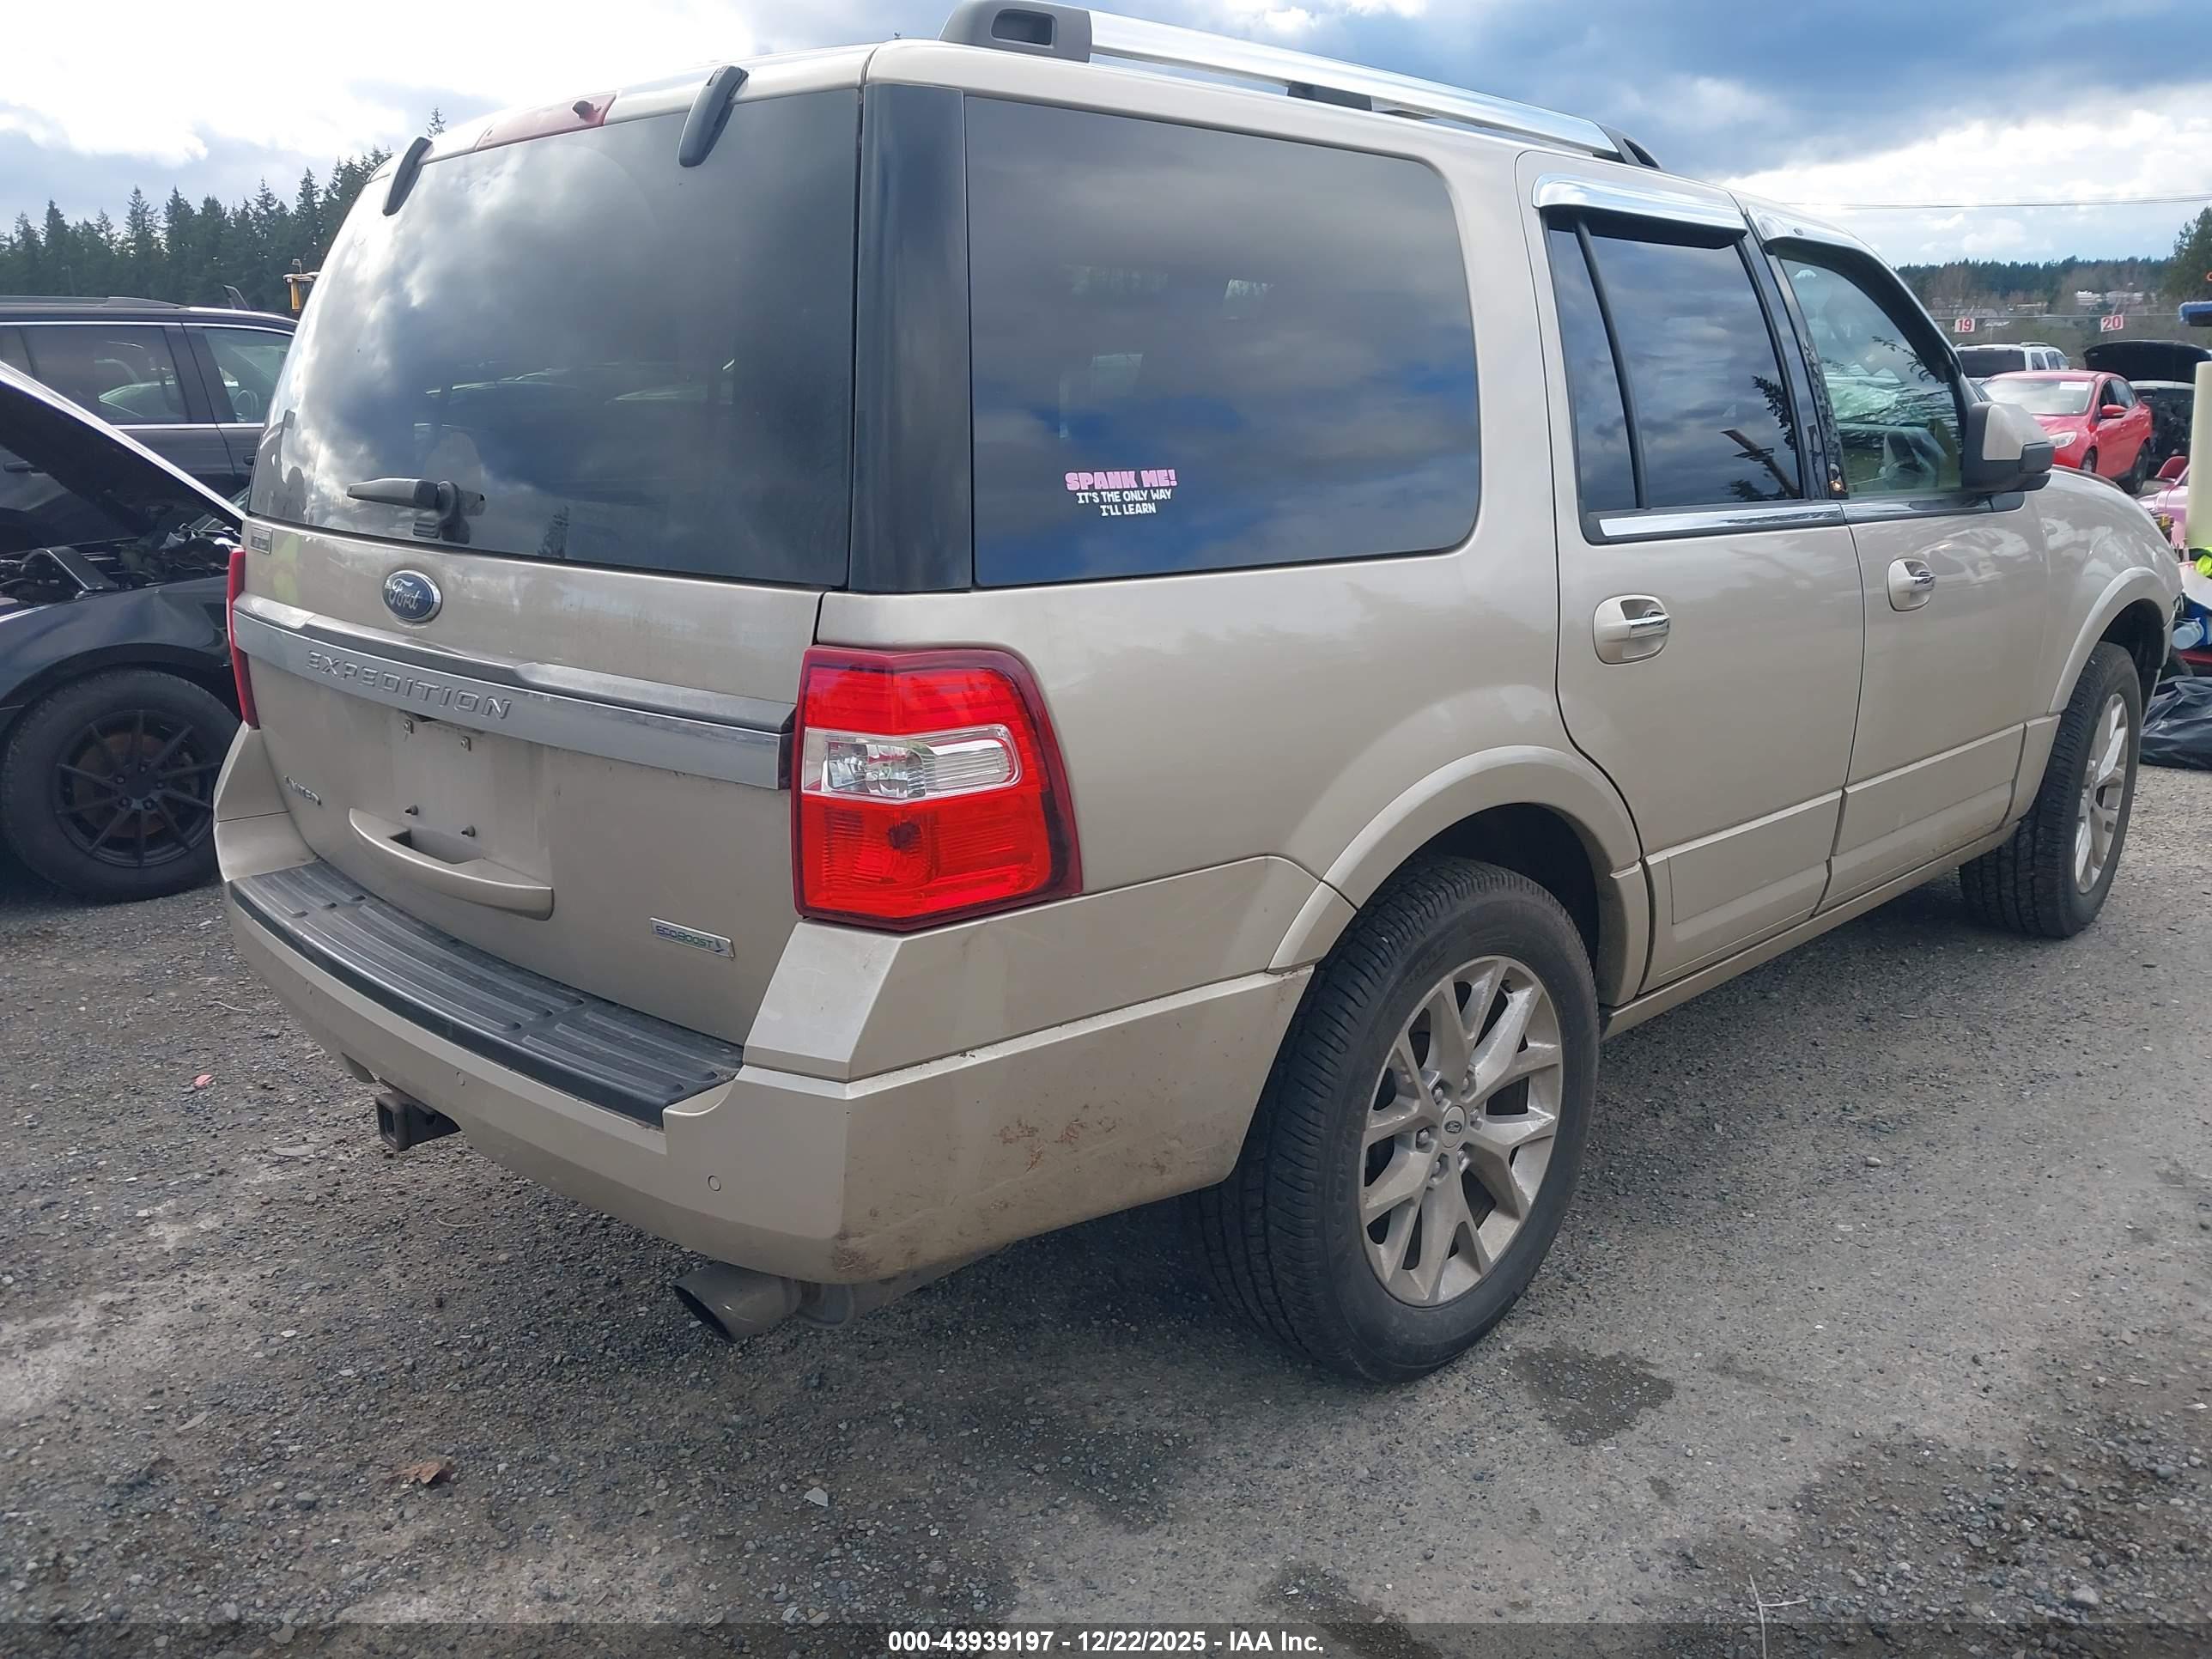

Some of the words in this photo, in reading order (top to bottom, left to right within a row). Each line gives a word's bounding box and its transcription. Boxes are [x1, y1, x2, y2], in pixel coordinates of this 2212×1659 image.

[1959, 319, 1972, 331] 19
[2102, 316, 2122, 331] 20
[1065, 471, 1139, 491] SPANK
[1140, 469, 1178, 488] ME!
[1076, 491, 1100, 504] IT'S
[1101, 490, 1121, 502] THE
[1122, 489, 1149, 502] ONLY
[1150, 489, 1172, 500] WAY
[1100, 503, 1121, 517] I'LL
[1123, 502, 1157, 515] LEARN
[388, 578, 421, 611] Ford
[306, 650, 513, 720] EXPEDITION
[655, 925, 714, 949] ECOBOOST
